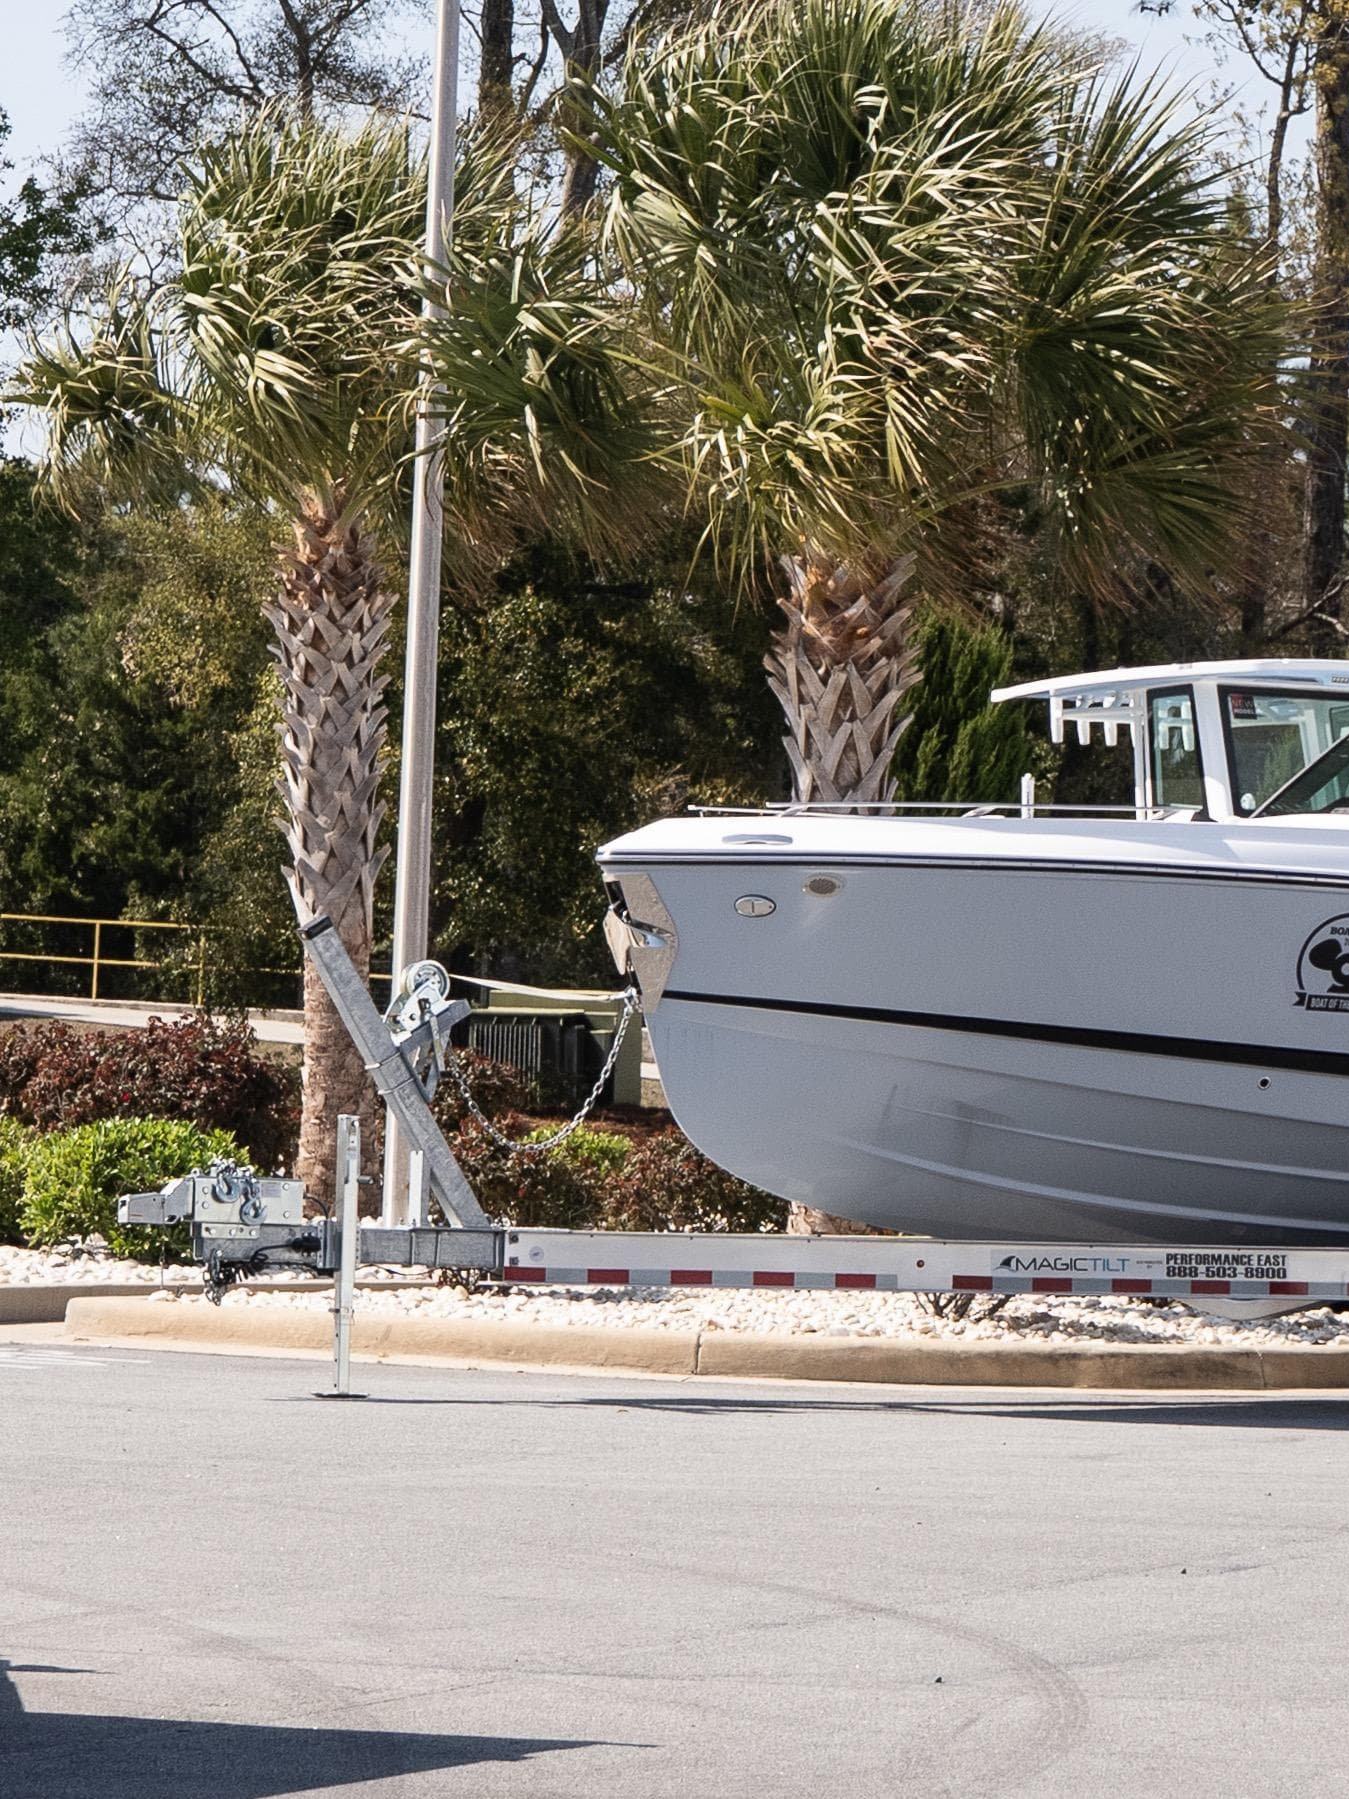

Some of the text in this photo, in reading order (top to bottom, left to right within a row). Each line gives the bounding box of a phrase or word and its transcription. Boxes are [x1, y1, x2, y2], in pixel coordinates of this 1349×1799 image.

[1311, 998, 1328, 1008] BOAT
[1329, 999, 1337, 1009] OF
[1016, 1257, 1130, 1272] MAGICTILT
[1166, 1253, 1287, 1266] PERFORMANCE EAST
